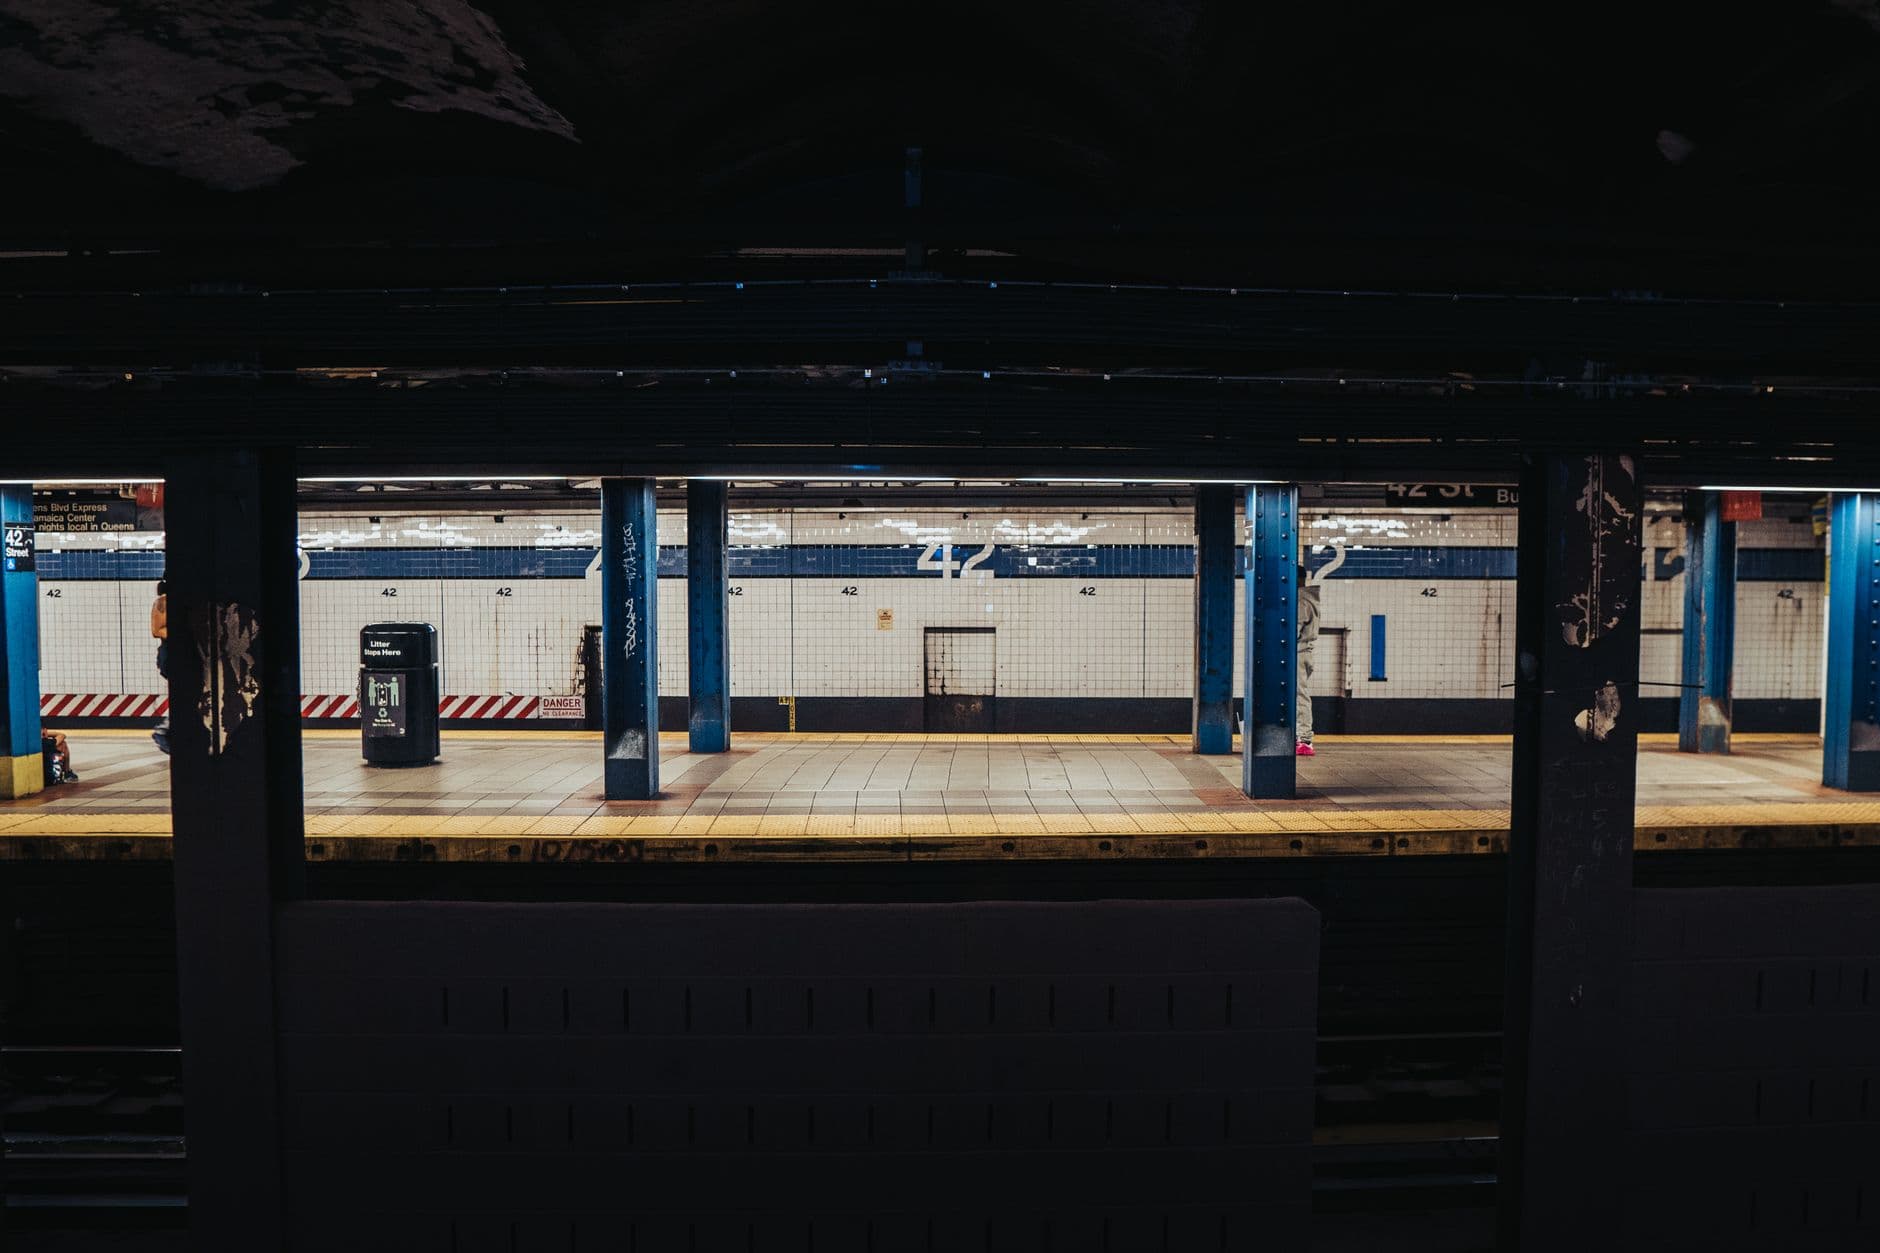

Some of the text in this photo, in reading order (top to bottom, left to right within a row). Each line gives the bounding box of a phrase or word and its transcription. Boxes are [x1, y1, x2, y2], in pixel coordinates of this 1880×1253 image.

[51, 503, 69, 512] Blvd
[72, 503, 107, 514] Express
[67, 513, 96, 521] Center
[39, 523, 64, 532] nights
[67, 522, 88, 531] local
[91, 522, 98, 531] in
[101, 522, 135, 531] Queens
[5, 529, 23, 547] 42
[5, 547, 29, 557] Street
[916, 537, 996, 580] 42
[46, 589, 61, 598] 42
[382, 588, 397, 597] 42
[496, 588, 512, 597] 42
[727, 587, 743, 596] 42
[842, 587, 858, 596] 42
[1080, 587, 1096, 596] 42
[1420, 587, 1437, 597] 42
[1777, 589, 1793, 599] 42
[543, 698, 581, 708] DANGER
